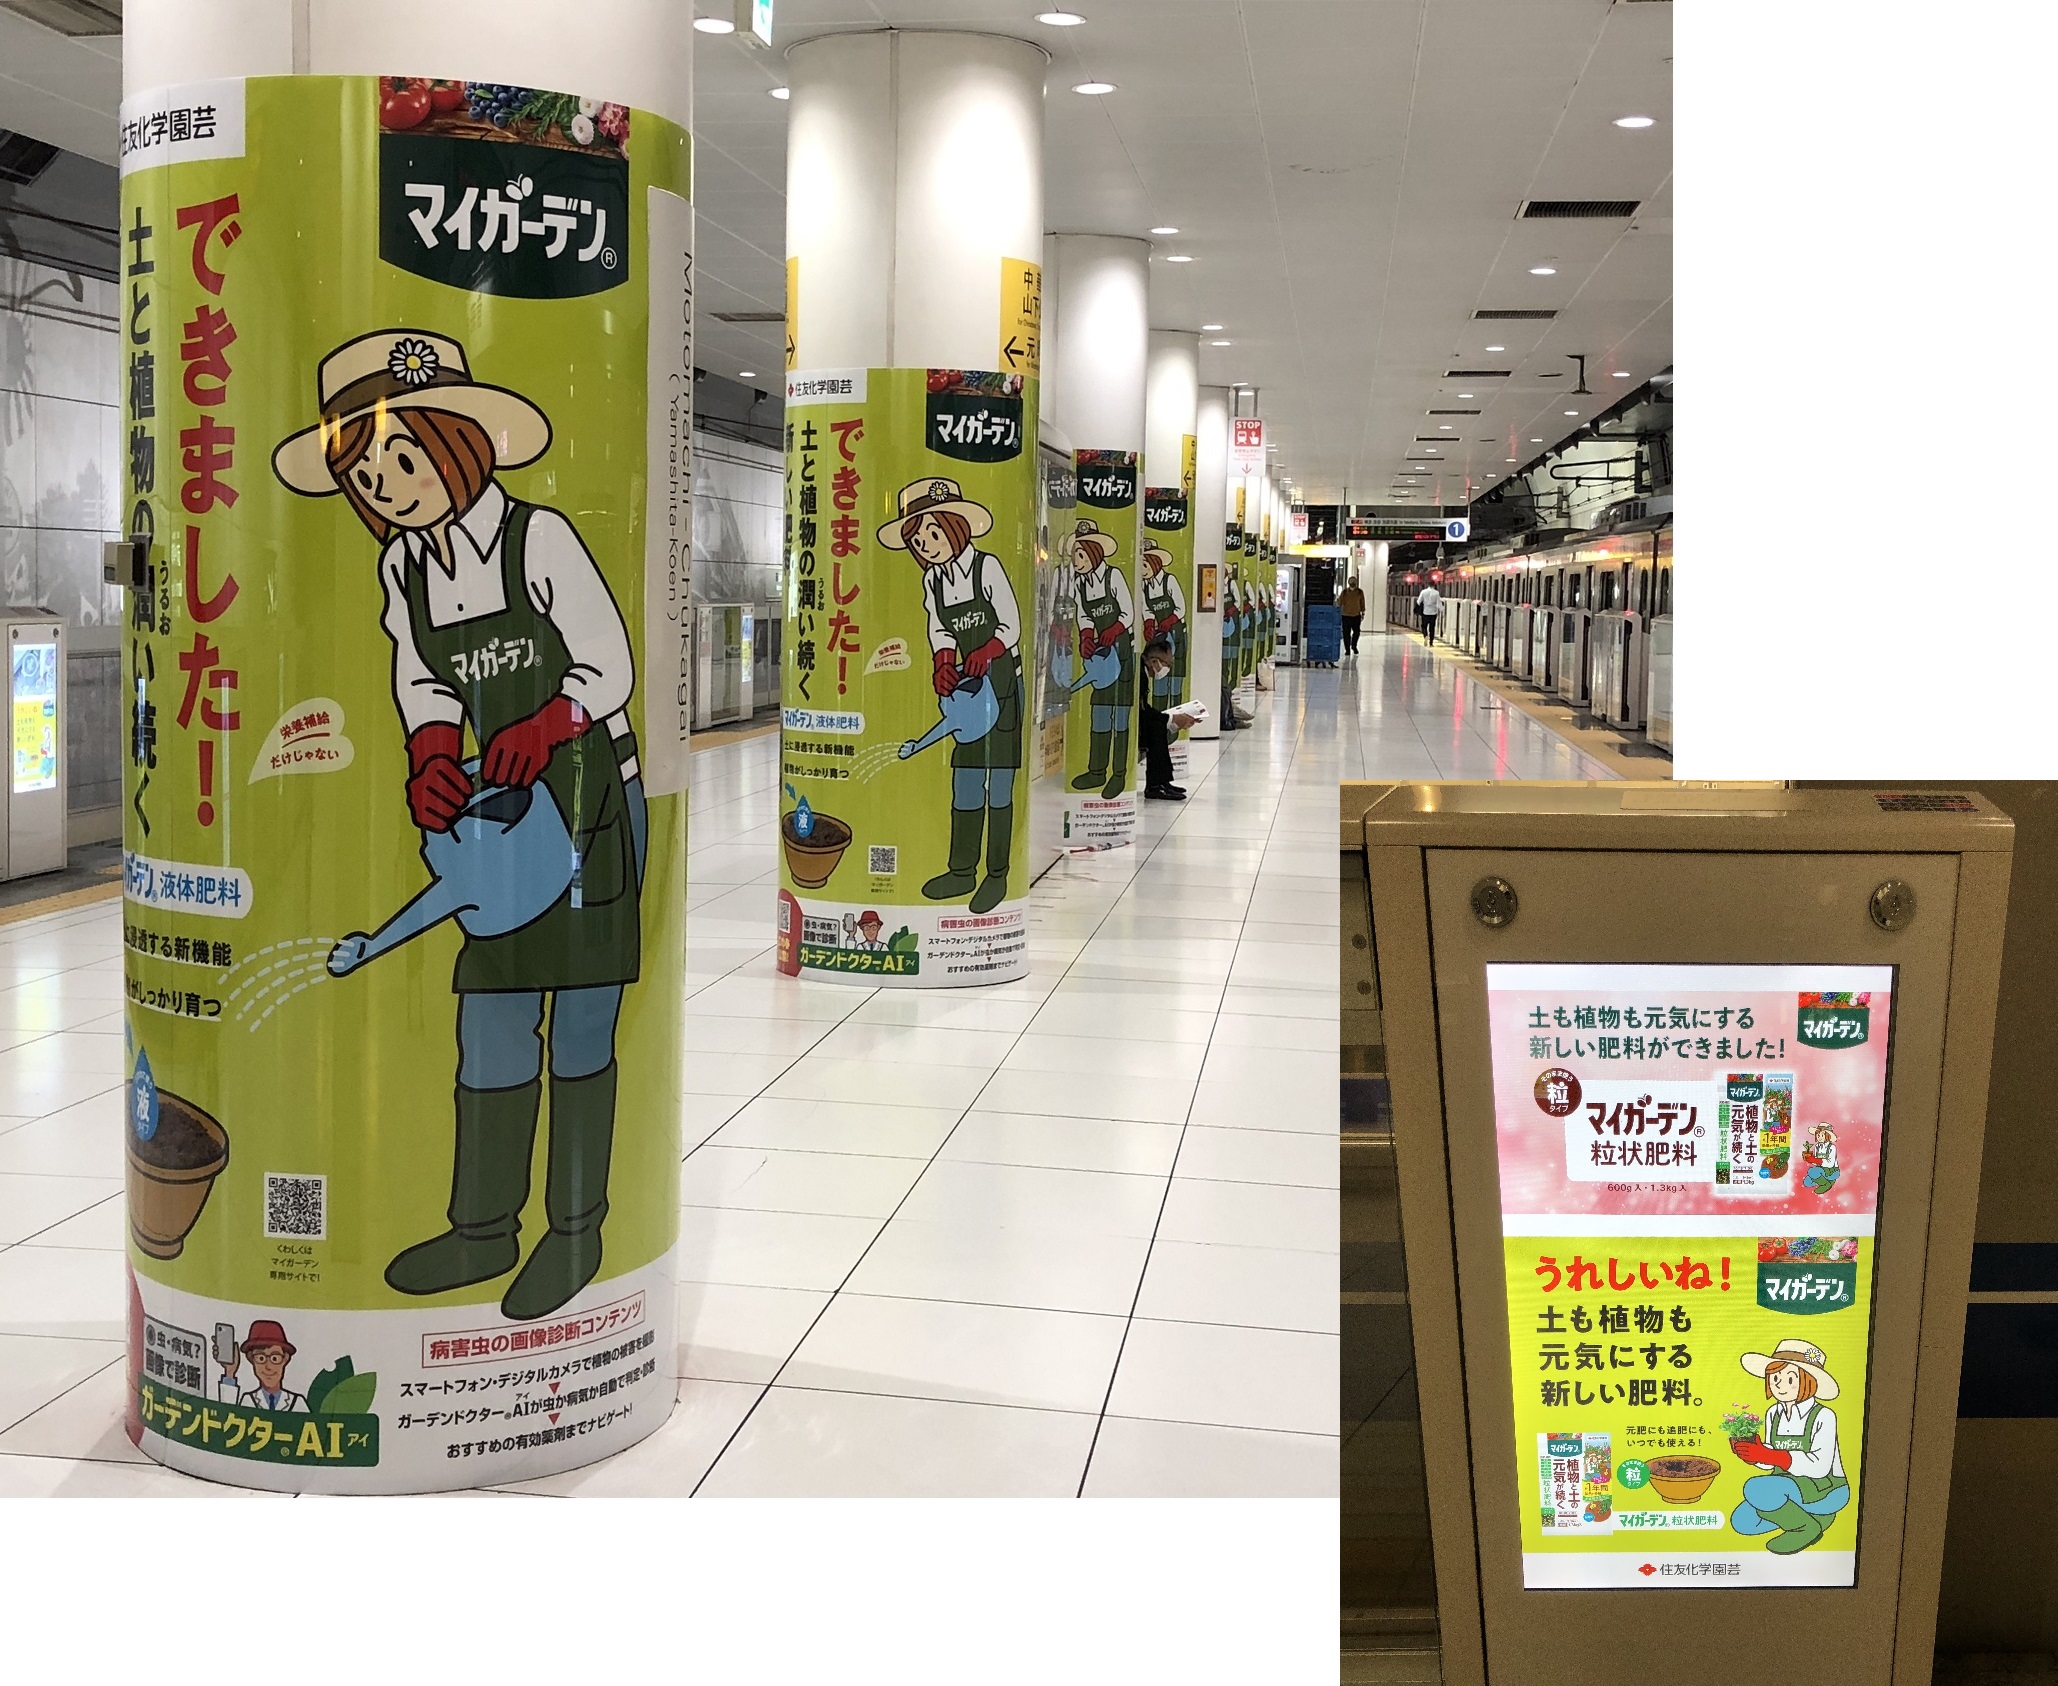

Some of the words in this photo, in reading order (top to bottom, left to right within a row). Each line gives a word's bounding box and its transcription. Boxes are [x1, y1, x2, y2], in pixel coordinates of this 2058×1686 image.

[682, 251, 693, 503] Motomachi
[794, 379, 853, 397] 住友化学園芸
[1236, 421, 1261, 429] STOP
[797, 420, 818, 701] 土と植物の潤い続く
[158, 561, 170, 635] うるお
[676, 543, 691, 741] Chukagai
[279, 711, 331, 740] 栄養補給
[815, 714, 860, 730] 液体肥料
[269, 747, 340, 769] だけじゃない
[160, 870, 241, 907] 液体肥料
[1528, 1006, 1755, 1030] 土も植物も元気にする
[1529, 1035, 1786, 1061] 新しい肥料ができました！
[1547, 1081, 1570, 1105] 粒
[1550, 1105, 1568, 1113] タイプ
[1731, 1104, 1744, 1164] 元気が続く
[1745, 1104, 1759, 1163] 植物と土の
[1590, 1140, 1698, 1166] 粒状肥料
[1535, 1256, 1731, 1291] うれしいね！
[429, 1300, 642, 1360] 病害虫の画像診断コンテンツ
[1536, 1305, 1692, 1334] 土も植物も
[1539, 1342, 1692, 1371] 元気にする
[1540, 1378, 1704, 1407] 新しい肥料。
[1627, 1438, 1702, 1448] いつでも使える！
[1553, 1459, 1566, 1510] 元気が続く
[1567, 1459, 1580, 1509] 植物と土の
[1625, 1467, 1641, 1481] 粒
[1671, 1515, 1718, 1525] 粒状肥料
[1660, 1563, 1741, 1577] 住友化学園芸
